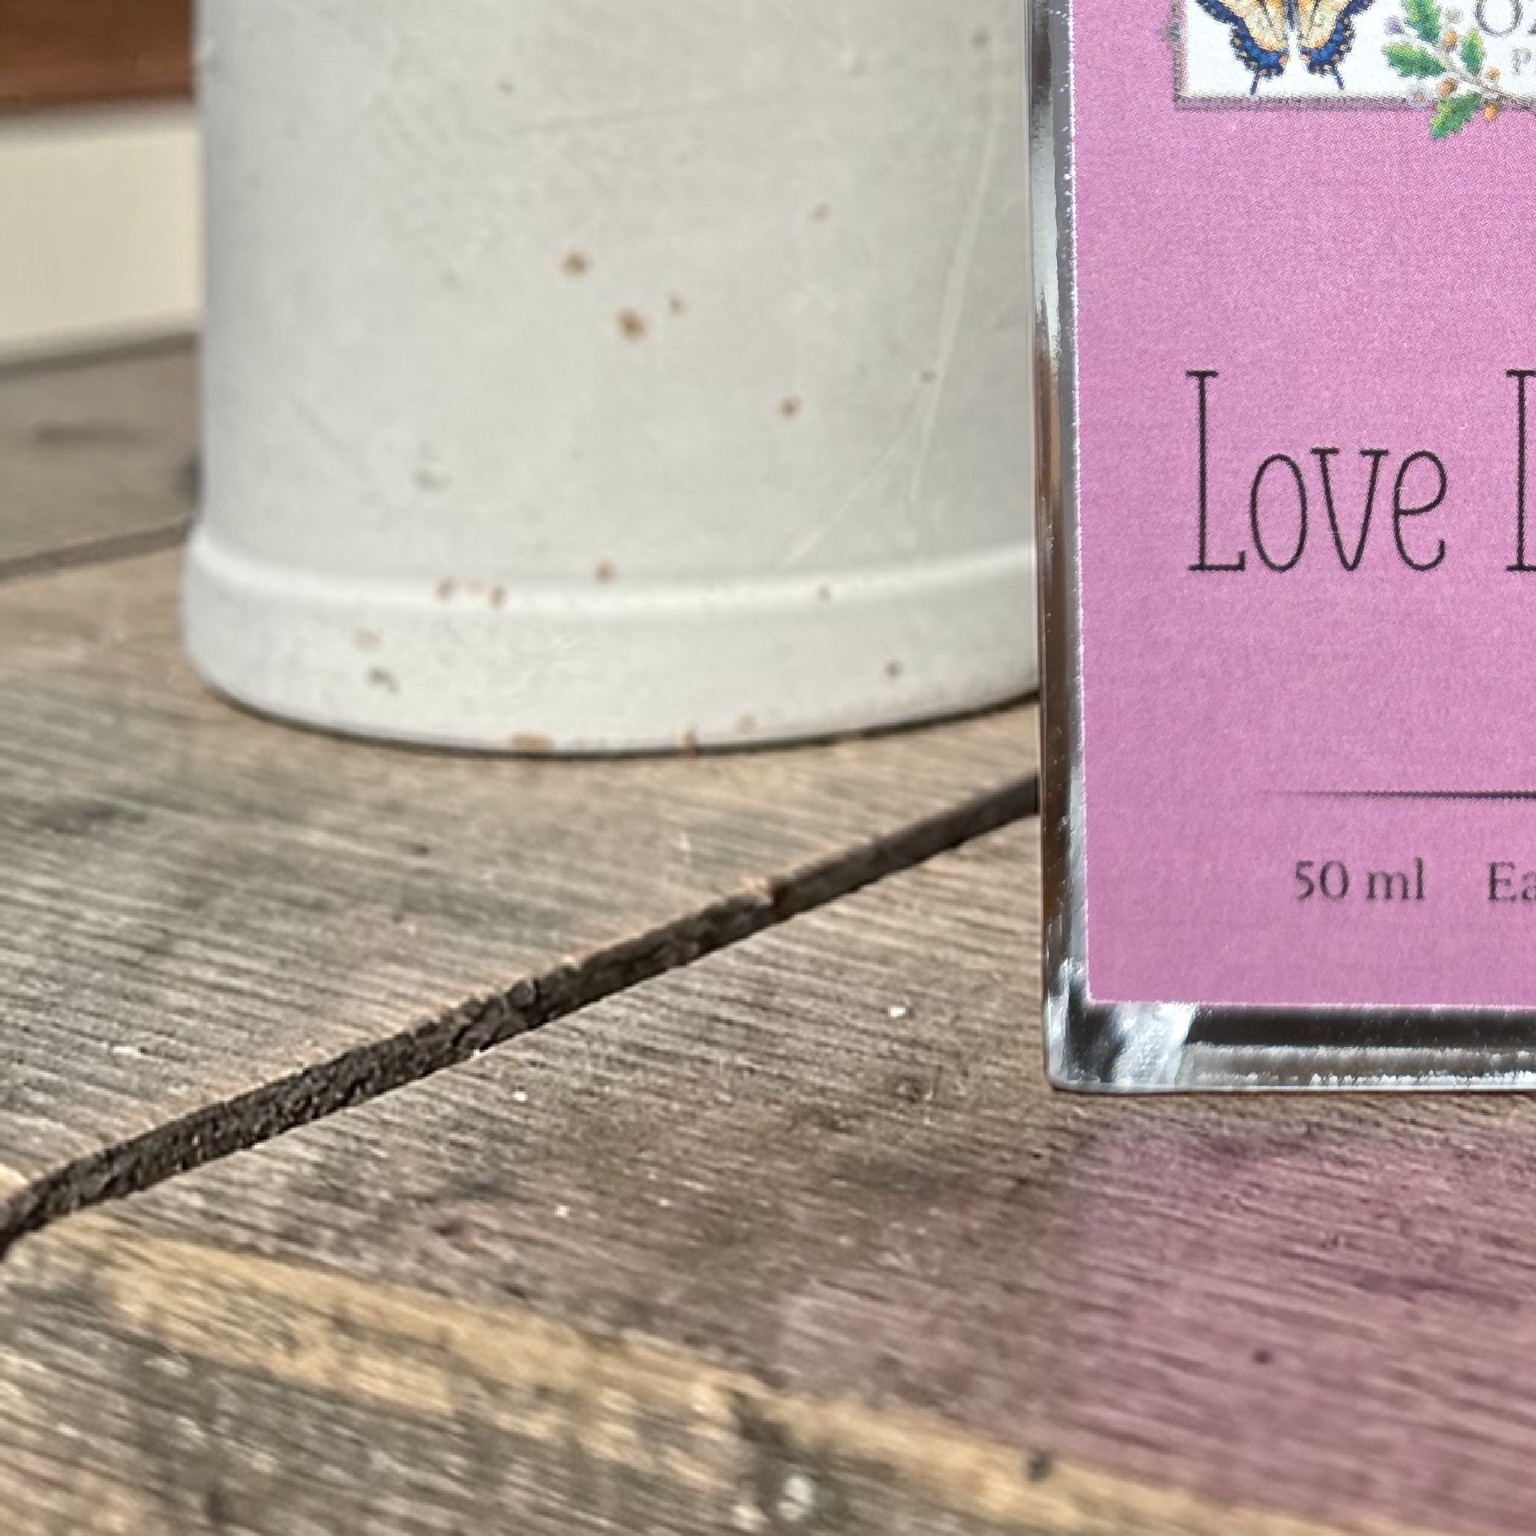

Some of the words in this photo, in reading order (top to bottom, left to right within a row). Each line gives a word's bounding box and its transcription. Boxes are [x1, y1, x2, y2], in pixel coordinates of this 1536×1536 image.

[1185, 368, 1449, 573] Love
[1293, 860, 1350, 902] 50
[1364, 857, 1427, 903] ml
